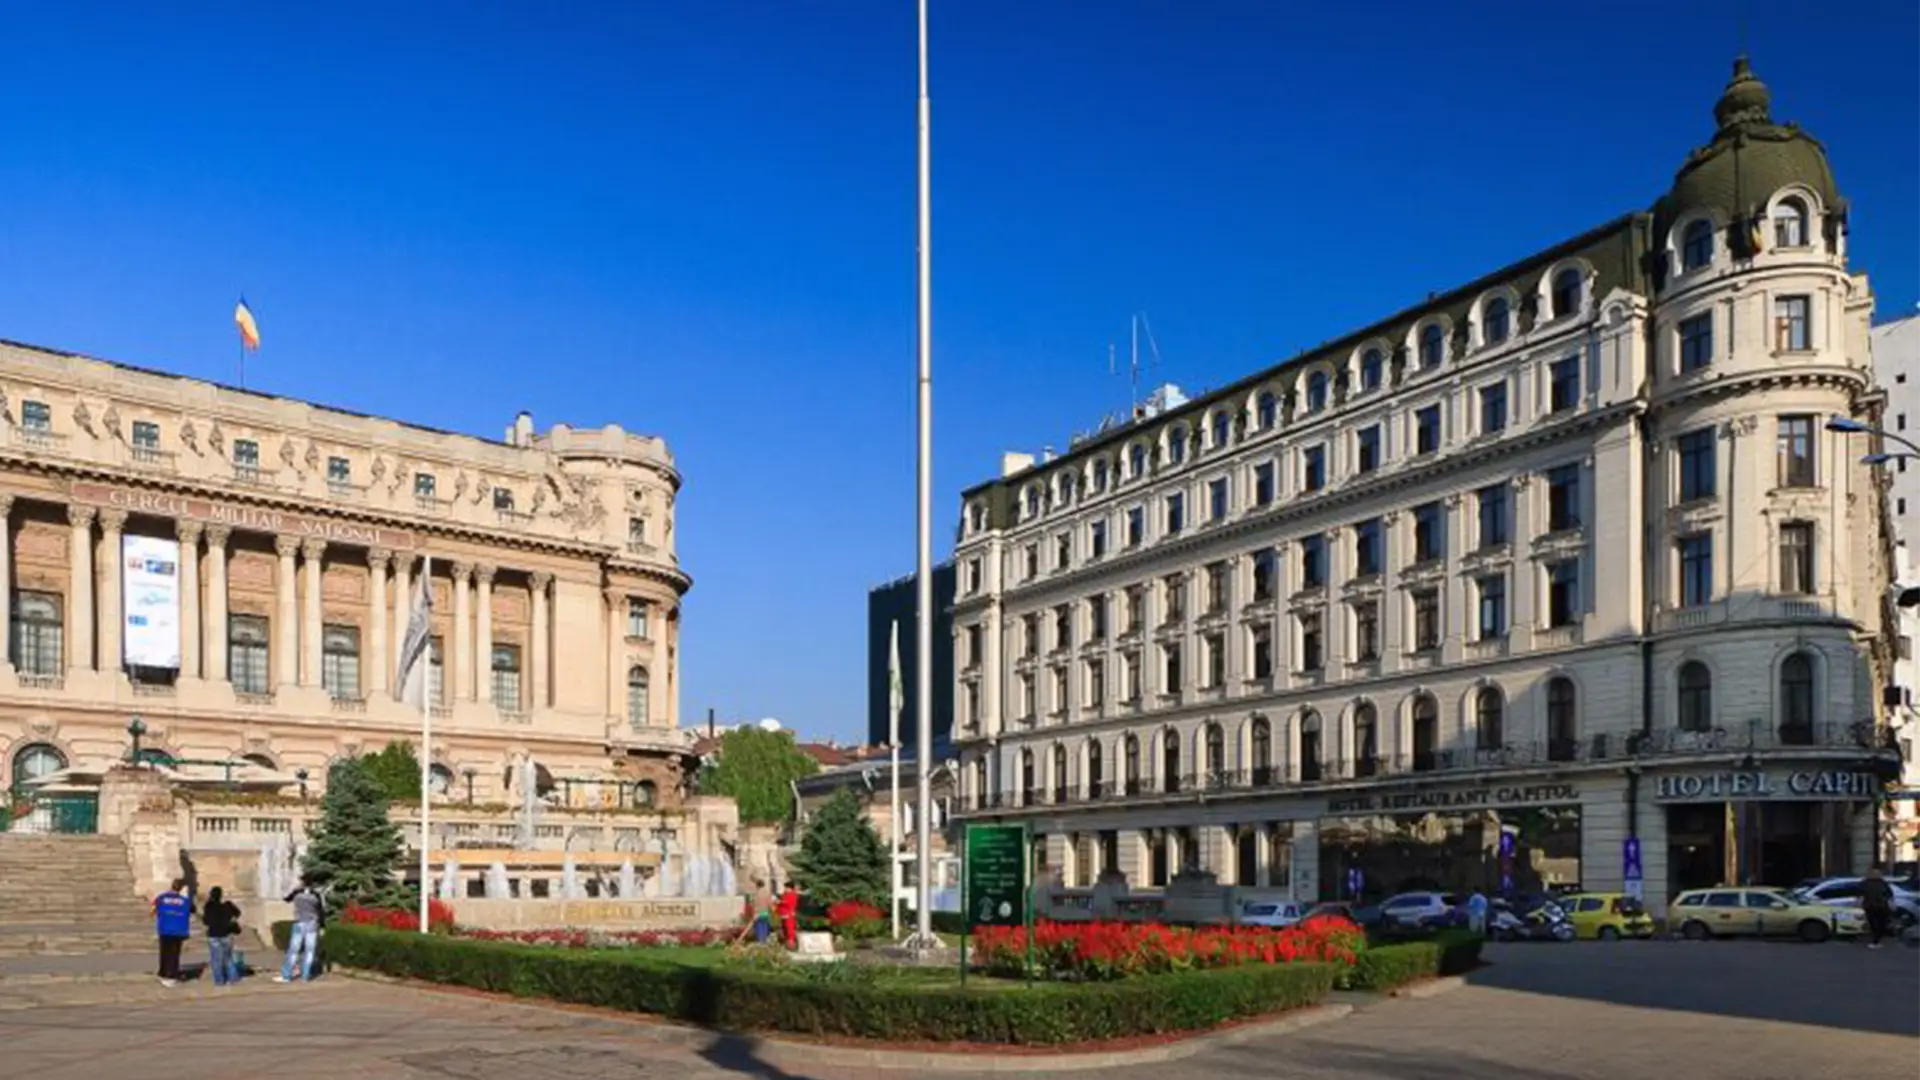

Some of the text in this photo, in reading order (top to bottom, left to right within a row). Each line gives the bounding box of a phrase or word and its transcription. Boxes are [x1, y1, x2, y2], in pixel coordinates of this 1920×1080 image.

[210, 503, 284, 531] MILITAR
[1497, 783, 1580, 803] CAPITOL
[1656, 771, 1776, 797] HOTEL
